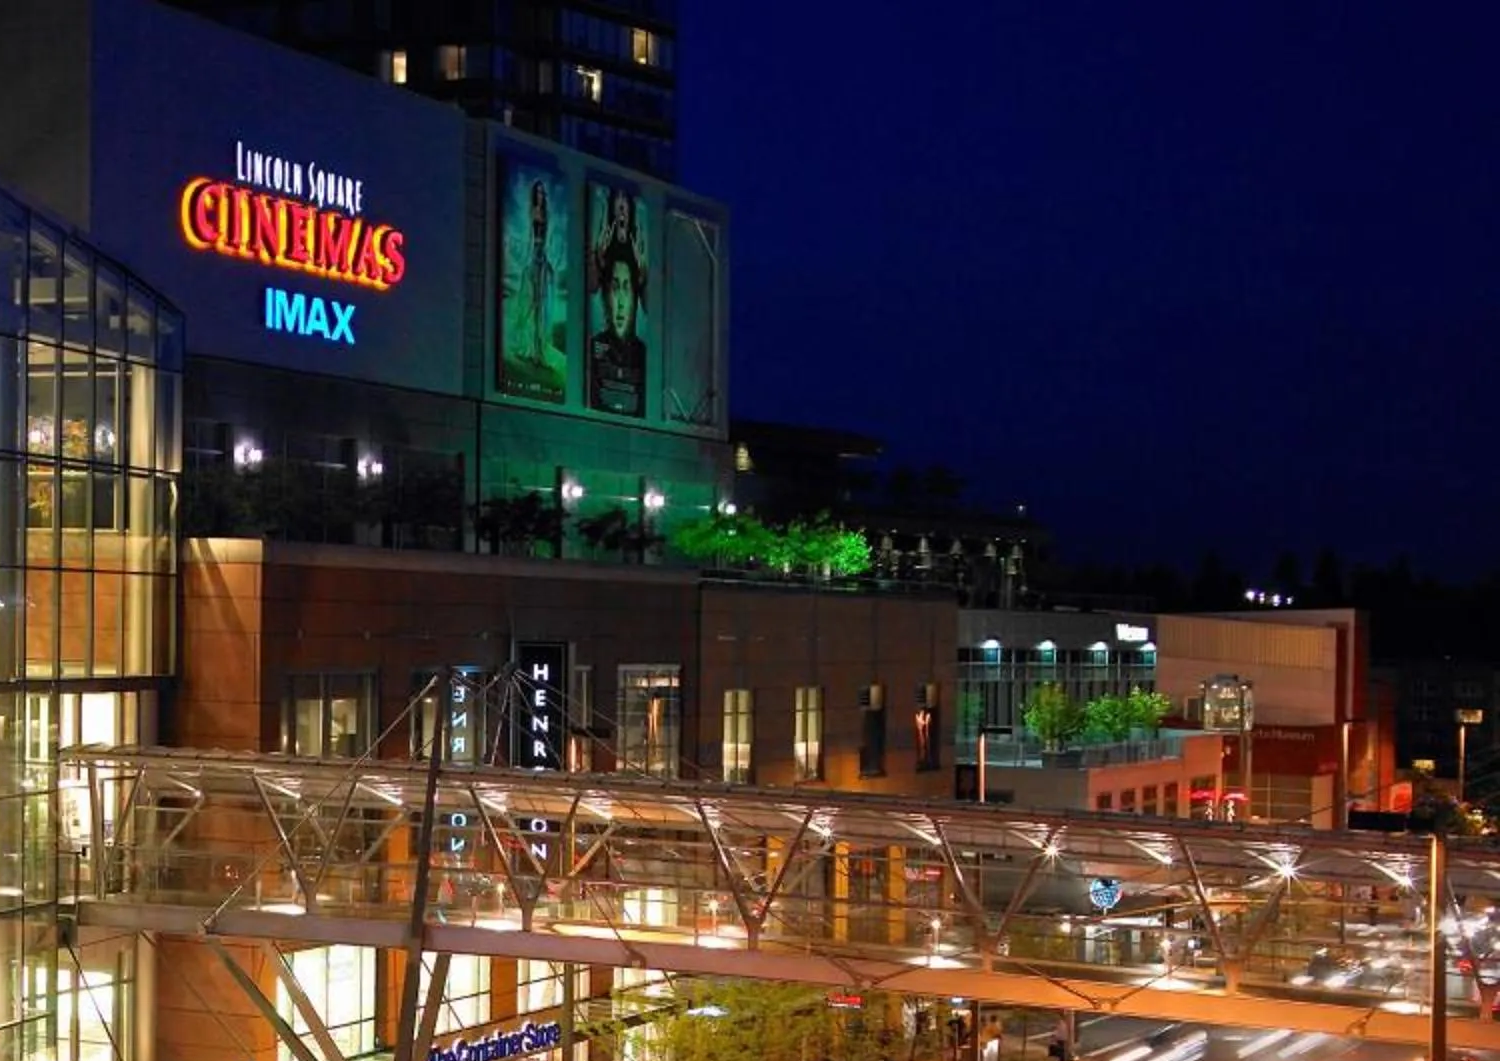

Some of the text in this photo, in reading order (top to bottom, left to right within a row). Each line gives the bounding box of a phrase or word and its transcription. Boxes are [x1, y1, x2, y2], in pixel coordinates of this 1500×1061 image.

[237, 141, 363, 216] LINCOLN SQUARE
[180, 177, 405, 290] CINEMAS
[265, 287, 356, 345] IMAX
[531, 663, 549, 860] HENRON
[520, 1020, 562, 1053] Store
